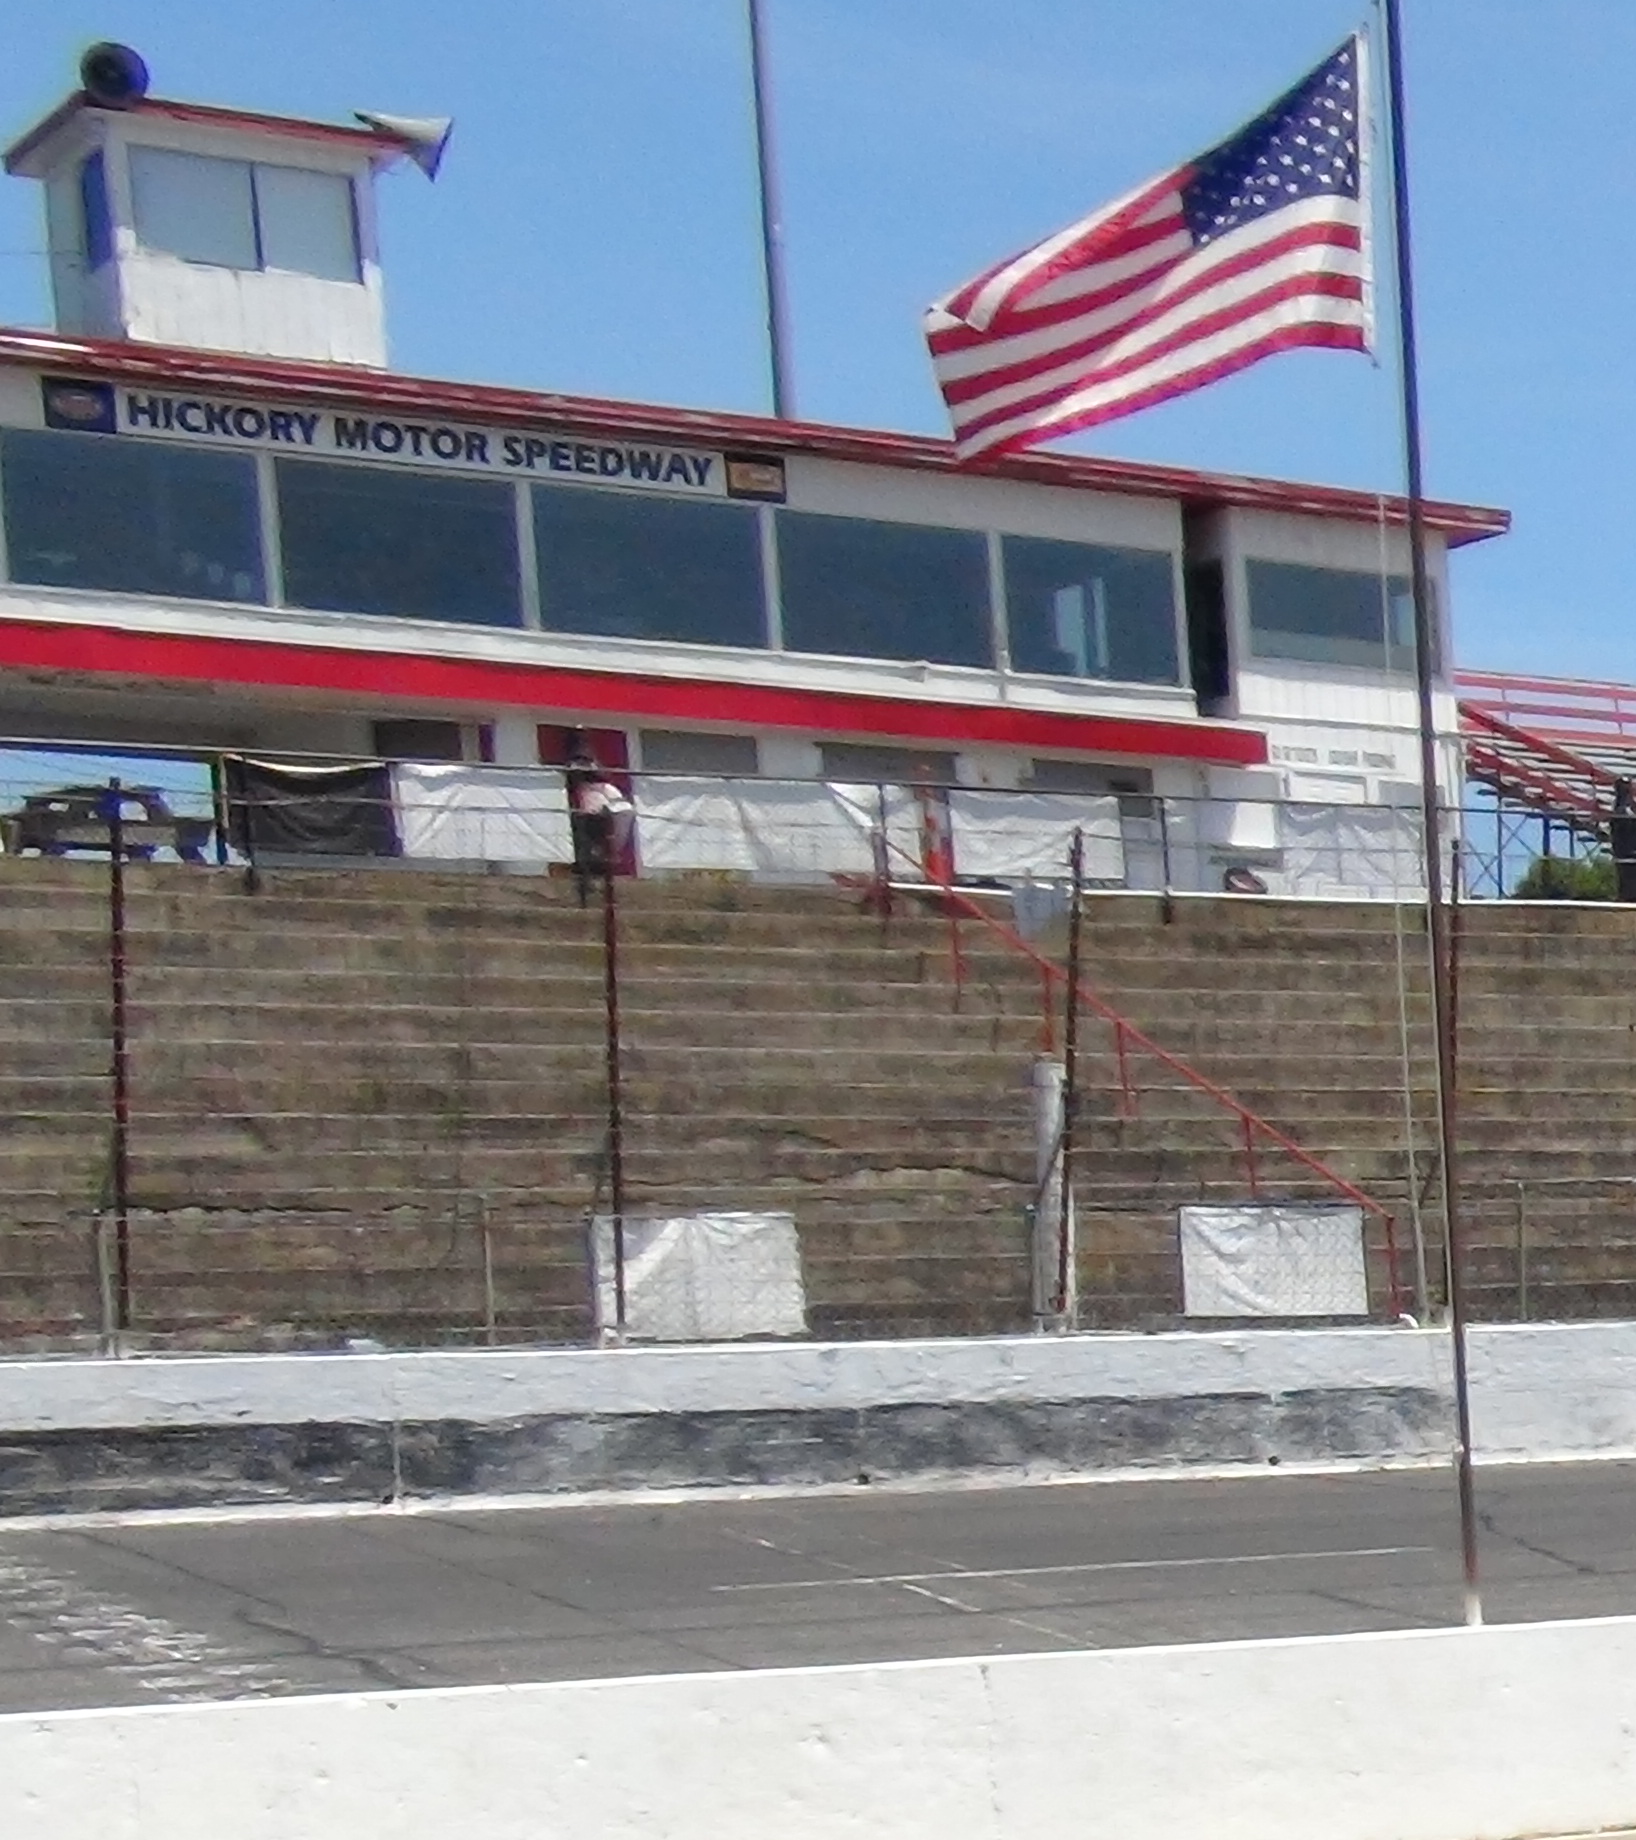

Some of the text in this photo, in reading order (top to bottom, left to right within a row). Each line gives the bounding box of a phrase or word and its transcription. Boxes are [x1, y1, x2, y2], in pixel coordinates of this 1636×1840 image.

[126, 393, 713, 487] HICKORY MOTOR SPEEDWAY
